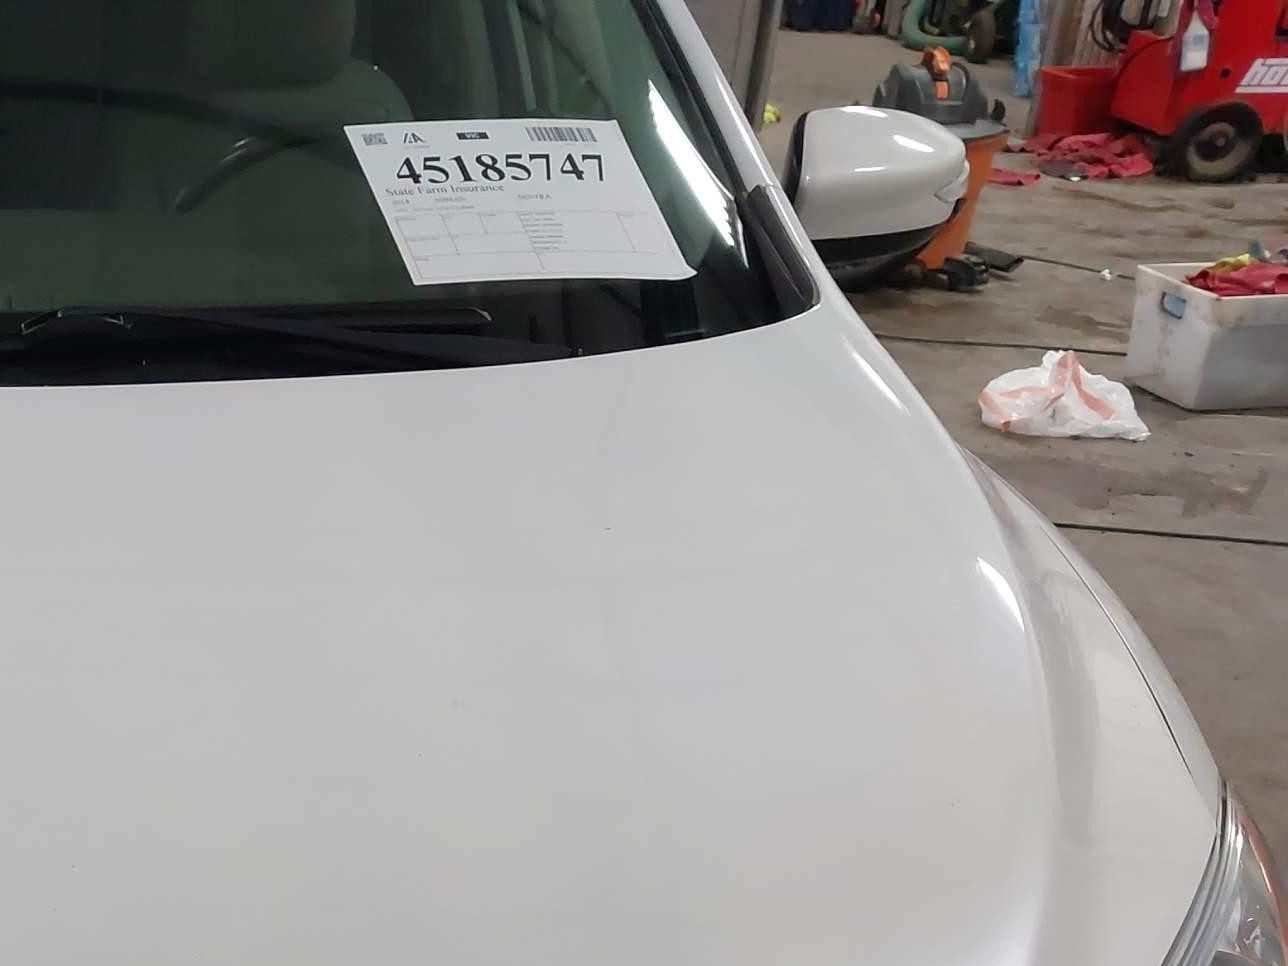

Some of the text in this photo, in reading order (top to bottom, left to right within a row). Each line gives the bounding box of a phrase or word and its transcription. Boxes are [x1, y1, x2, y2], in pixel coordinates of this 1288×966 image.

[396, 153, 604, 184] 45185747
[385, 184, 505, 197] State Farm Insurance
